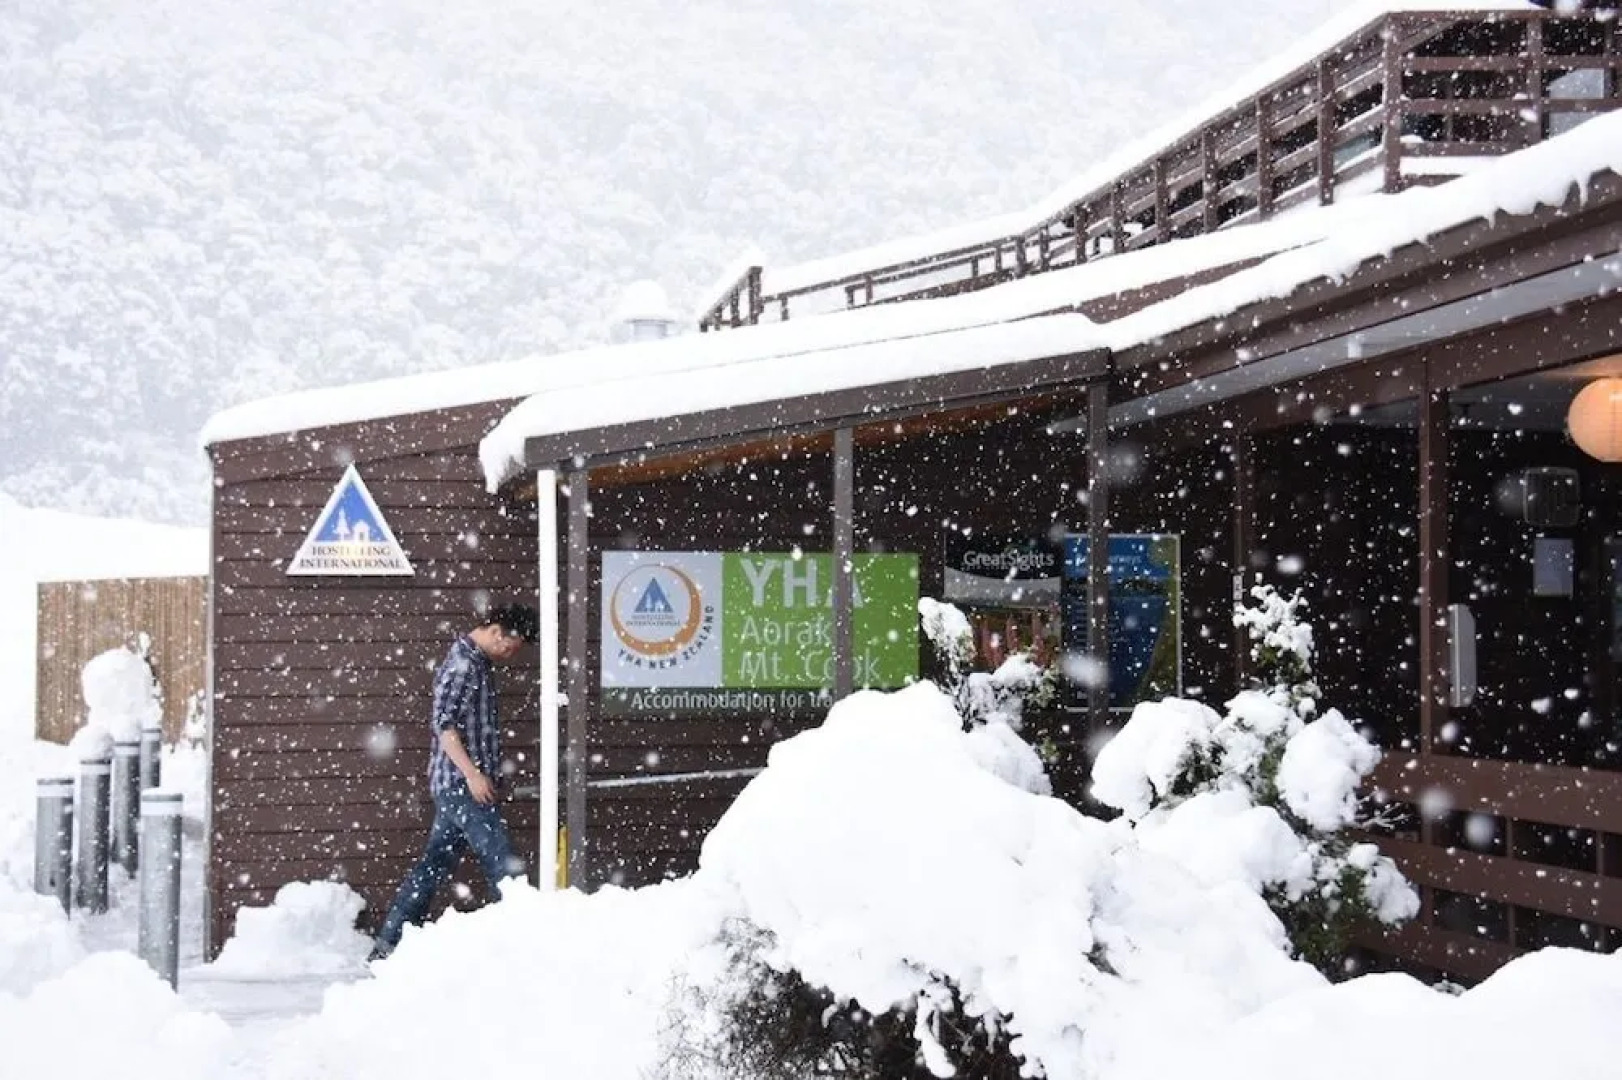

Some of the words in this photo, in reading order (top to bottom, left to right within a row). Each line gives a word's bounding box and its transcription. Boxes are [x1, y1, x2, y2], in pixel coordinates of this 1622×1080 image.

[300, 558, 401, 569] INTERNATIONAL
[963, 551, 1055, 571] GreatSights
[649, 657, 677, 669] NEW
[631, 691, 776, 708] Accommodation
[781, 690, 805, 708] for
